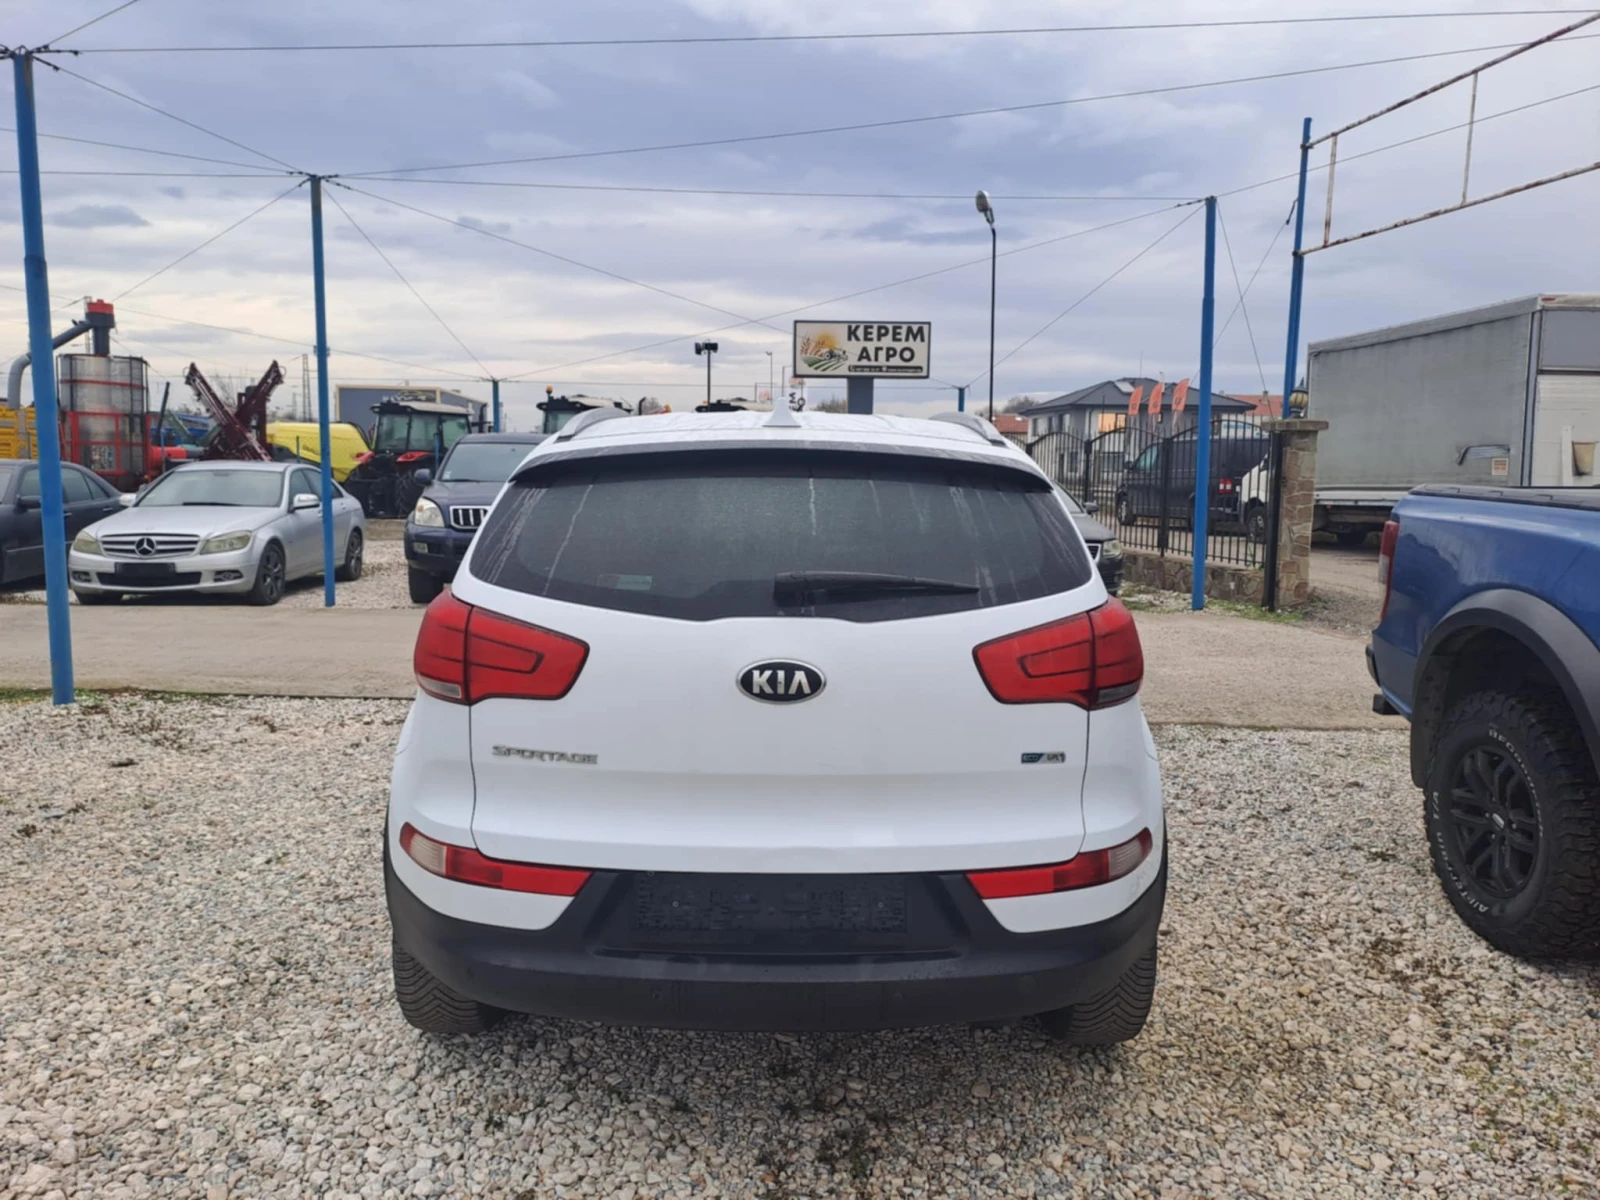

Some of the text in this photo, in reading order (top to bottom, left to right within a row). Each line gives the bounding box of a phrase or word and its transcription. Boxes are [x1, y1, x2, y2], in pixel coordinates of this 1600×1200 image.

[847, 325, 925, 342] КЕРЕМ
[857, 346, 915, 362] АГРО
[752, 670, 811, 694] KIA
[492, 745, 598, 764] SPORTAGE
